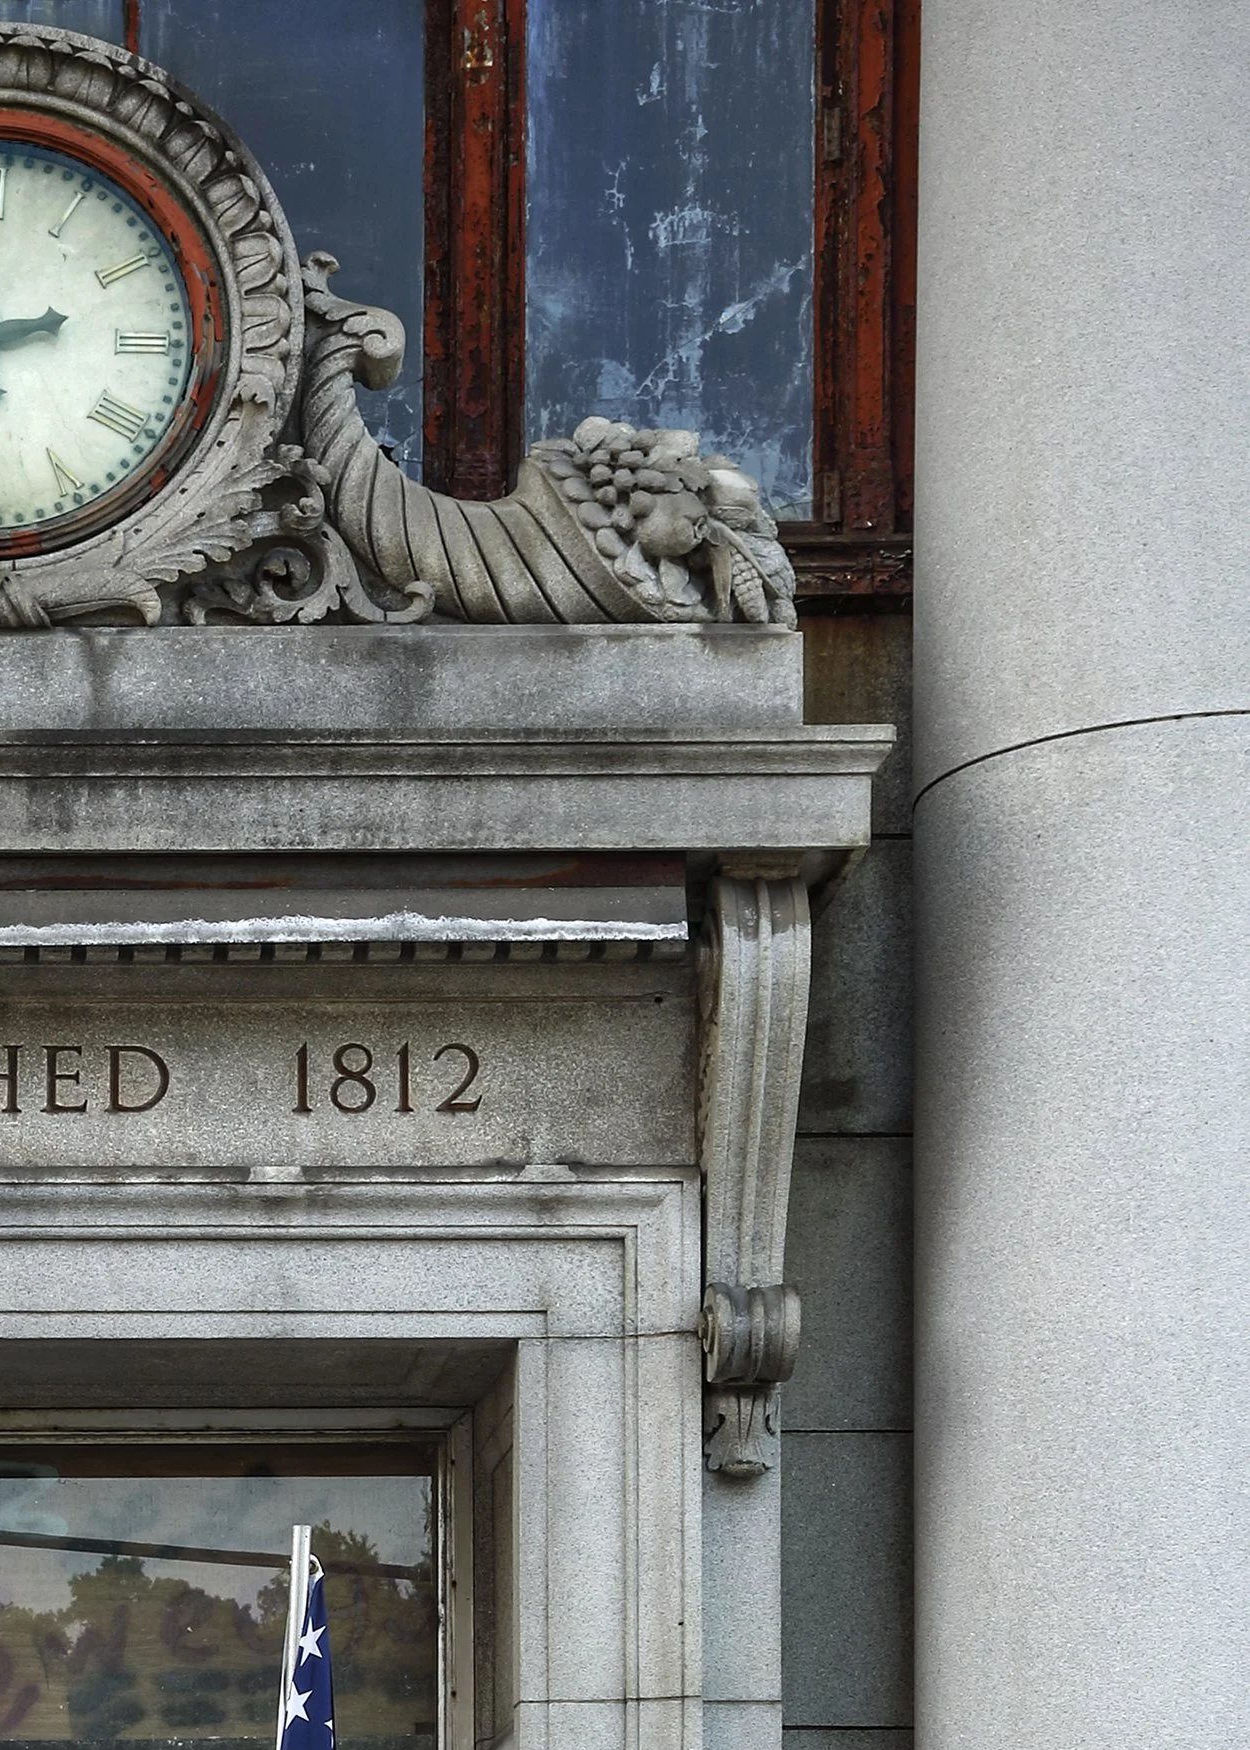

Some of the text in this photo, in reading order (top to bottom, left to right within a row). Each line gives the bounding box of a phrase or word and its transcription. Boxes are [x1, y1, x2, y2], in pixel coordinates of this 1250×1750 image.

[48, 190, 86, 238] I
[94, 251, 150, 289] II
[114, 328, 171, 355] III
[45, 446, 84, 498] V
[290, 1040, 484, 1114] 1812
